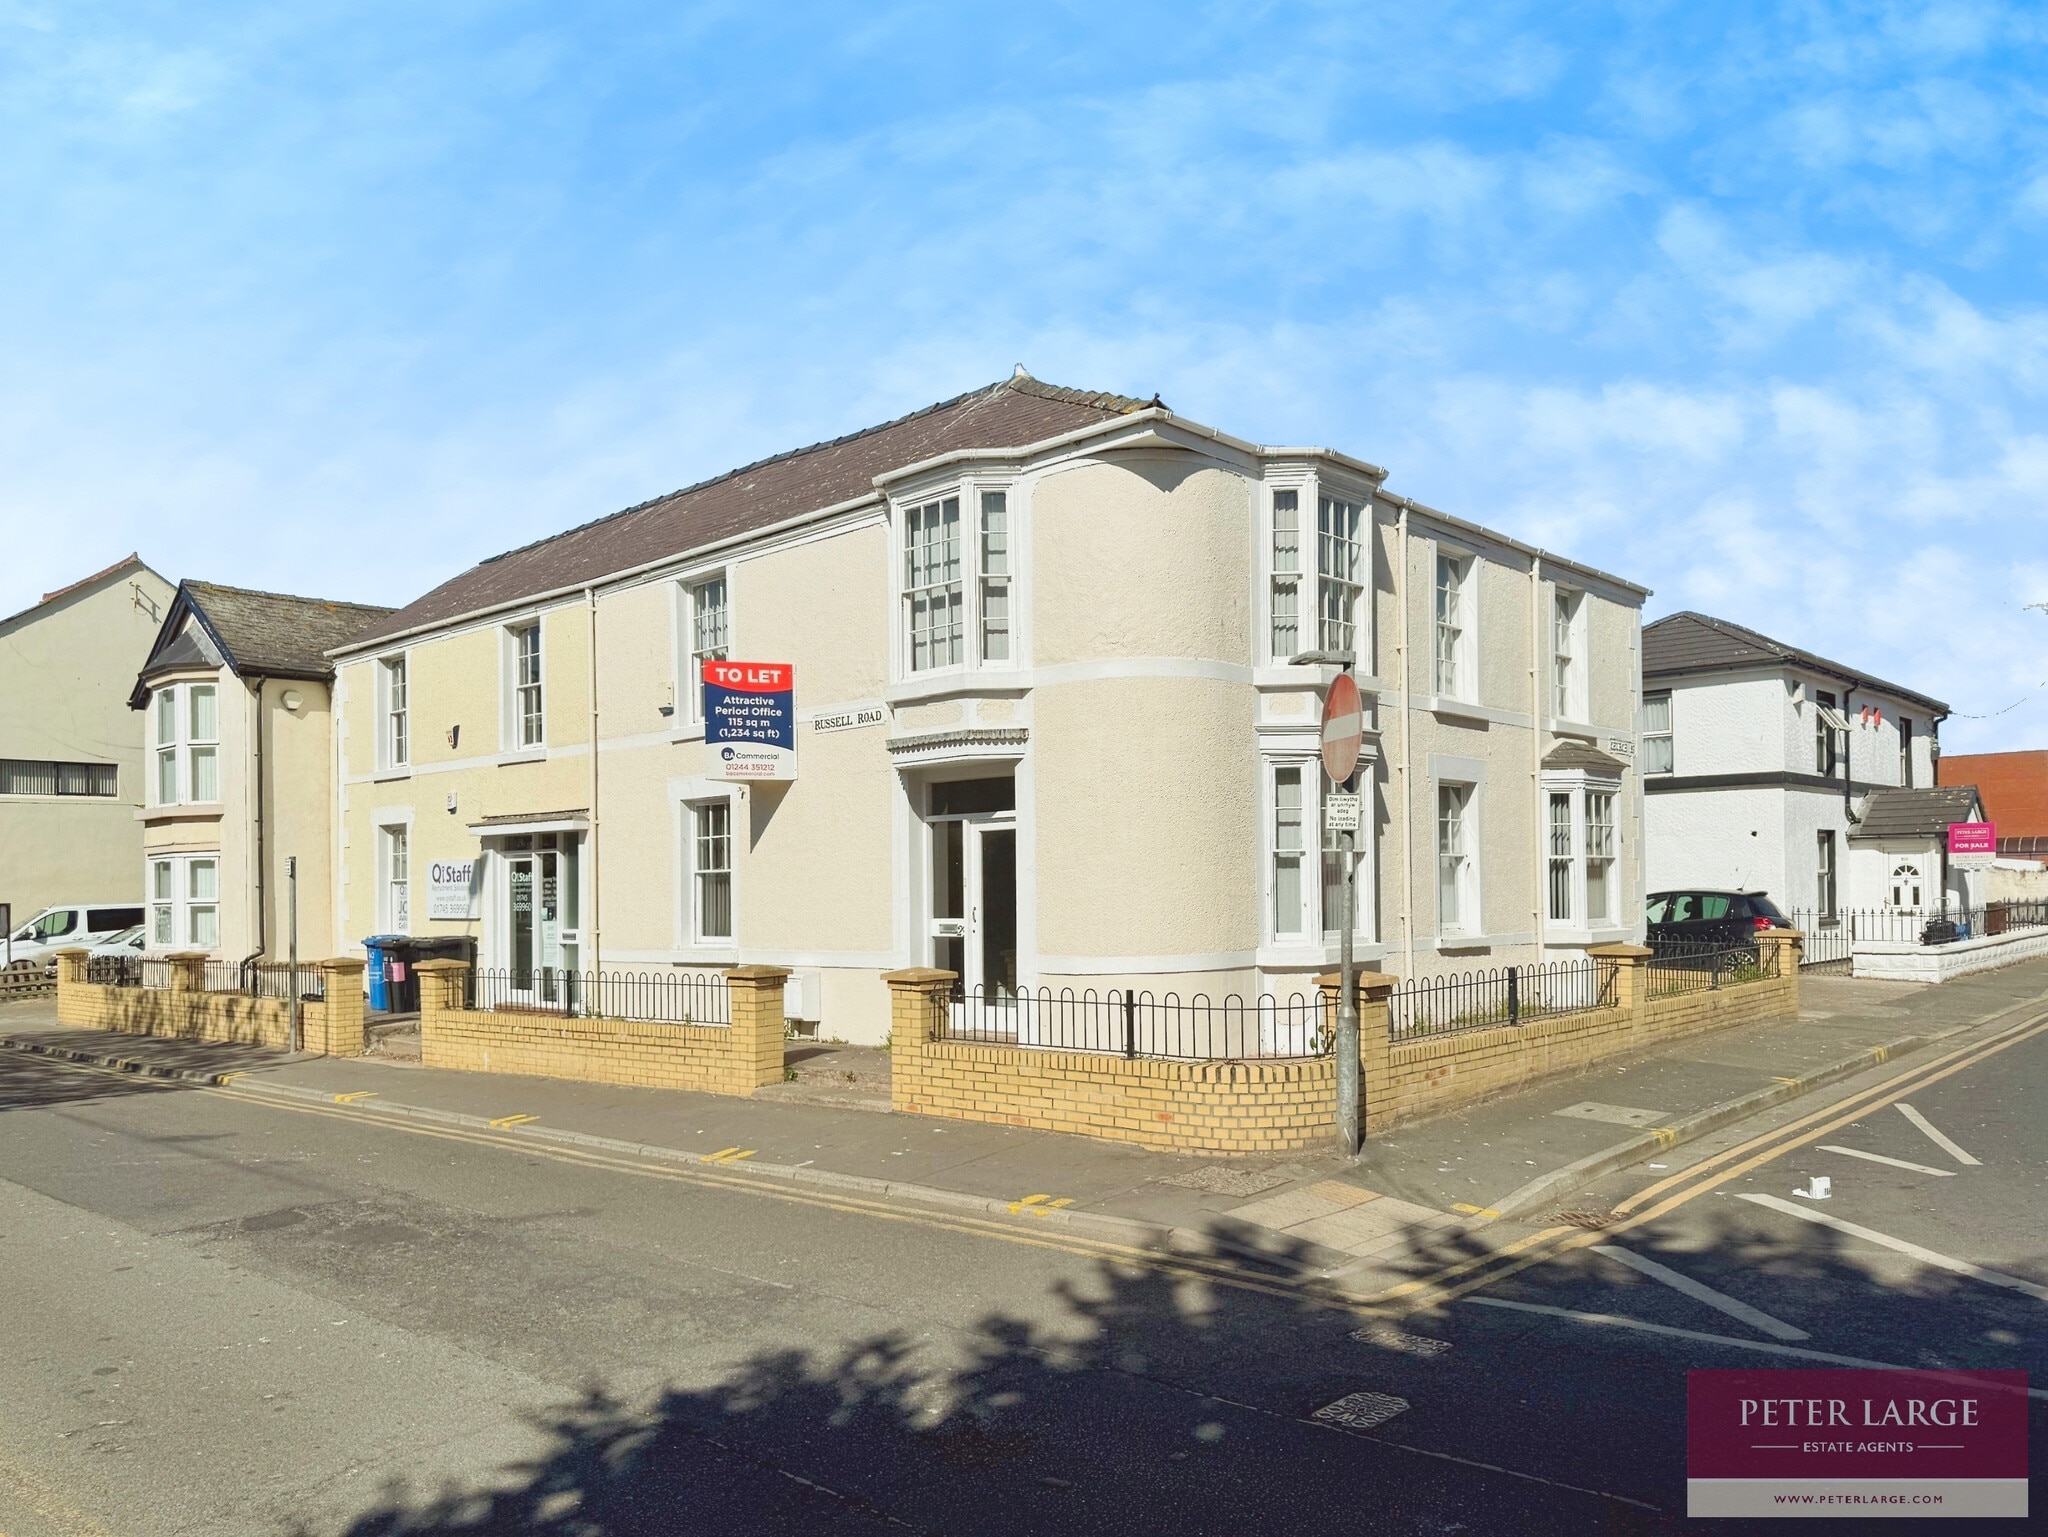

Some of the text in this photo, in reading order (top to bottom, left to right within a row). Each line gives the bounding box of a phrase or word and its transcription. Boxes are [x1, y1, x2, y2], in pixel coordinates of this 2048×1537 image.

[715, 668, 781, 684] TO LET
[723, 696, 774, 705] Attractive
[715, 706, 782, 716] Period Office
[728, 718, 742, 726] 115
[746, 719, 757, 728] sq
[815, 711, 882, 730] RUSSELL ROAD
[719, 728, 780, 739] (1,234 sq ft)
[736, 752, 779, 760] Commercial
[434, 904, 470, 913] 01745 369960
